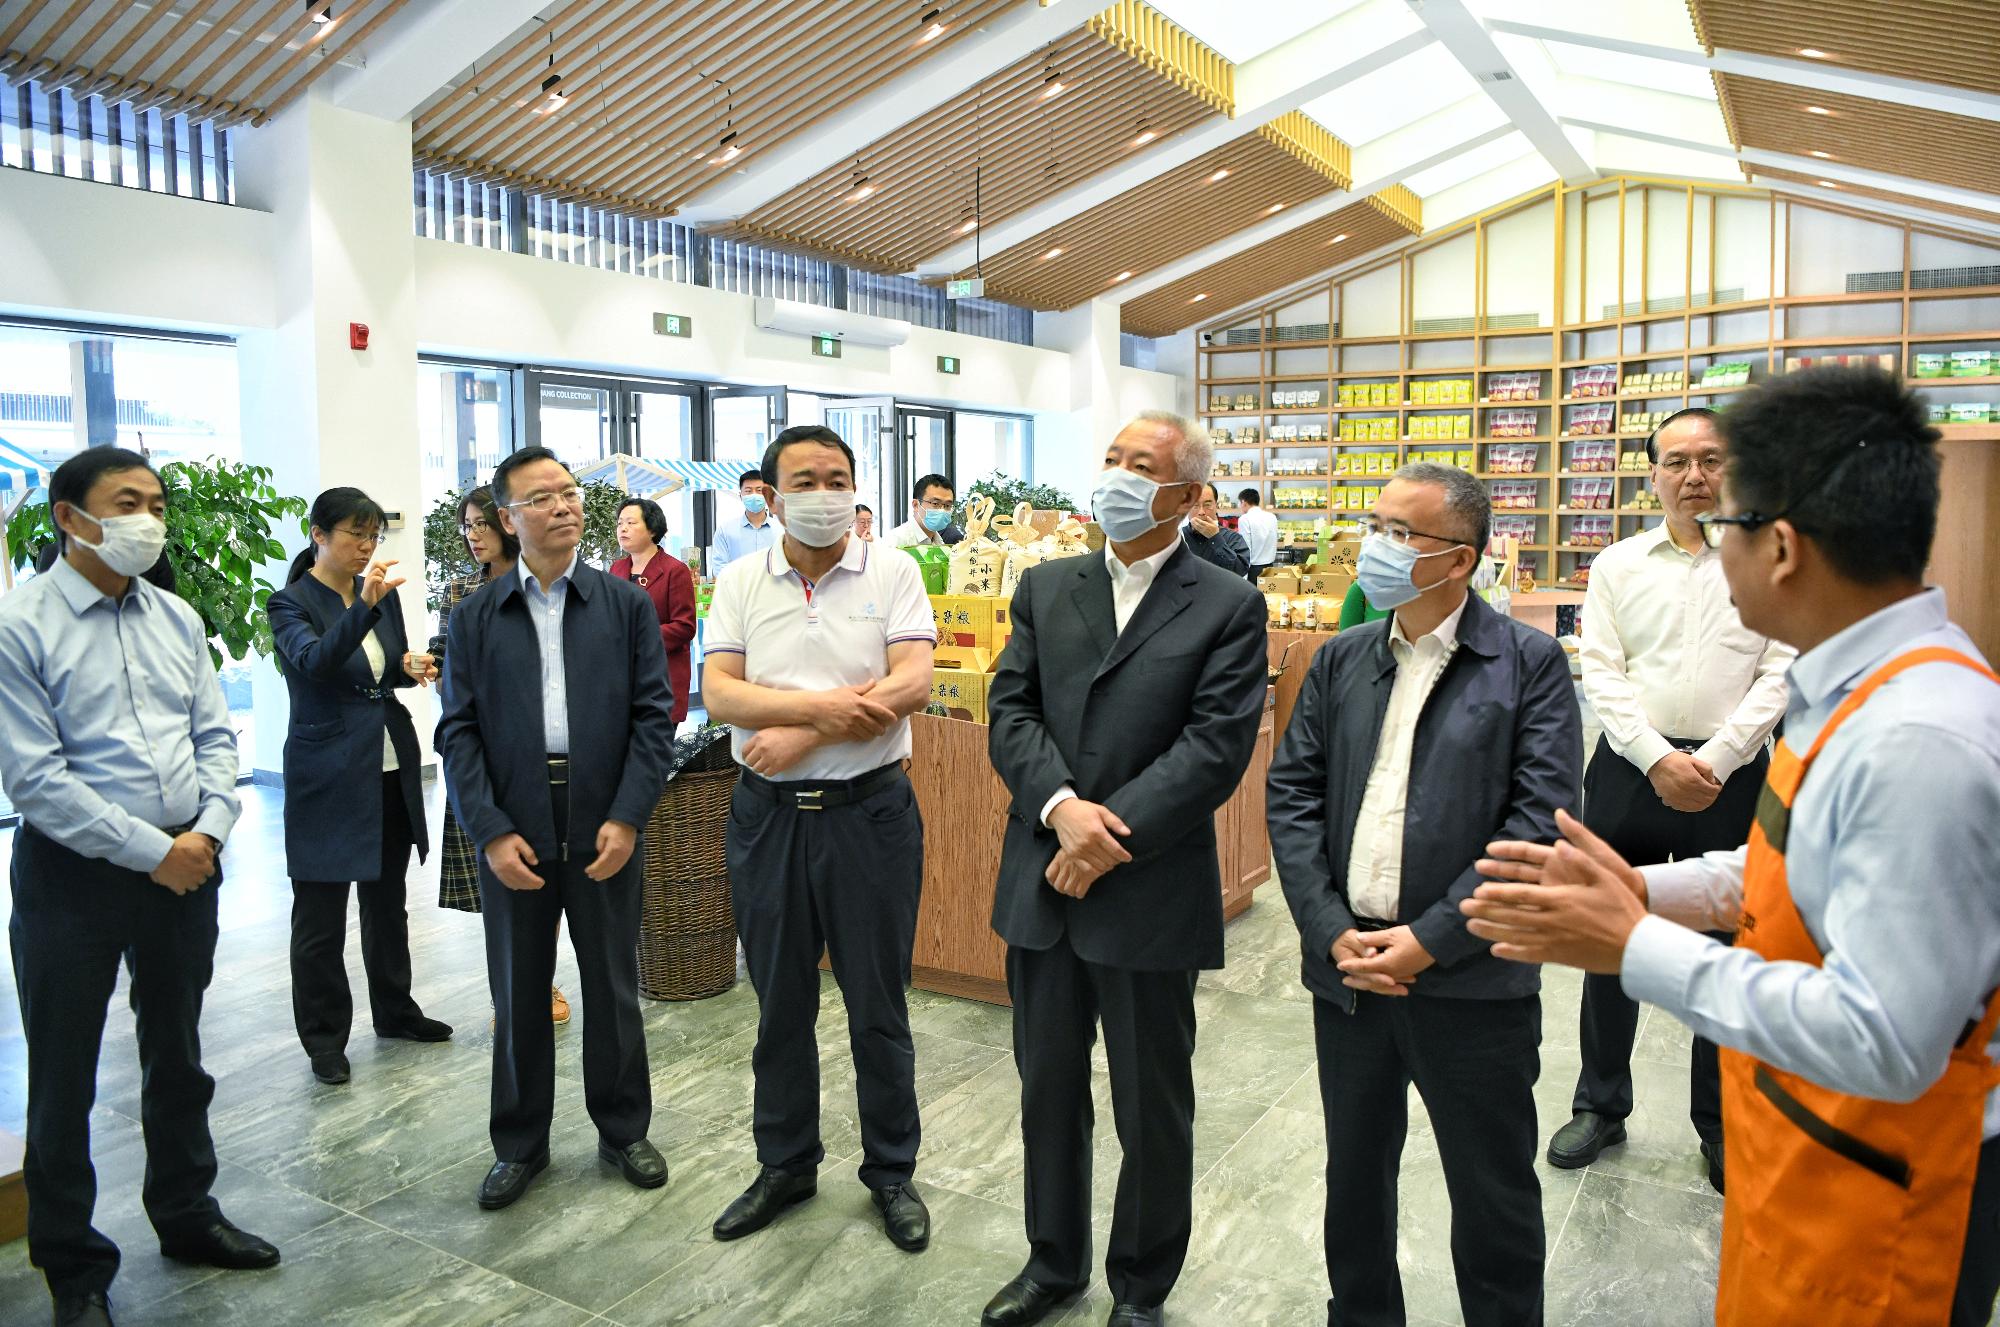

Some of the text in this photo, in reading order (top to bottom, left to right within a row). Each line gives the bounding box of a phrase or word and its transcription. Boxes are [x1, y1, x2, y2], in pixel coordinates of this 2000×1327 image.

[540, 389, 592, 400] ANG COLLECTION
[980, 563, 992, 591] 小米
